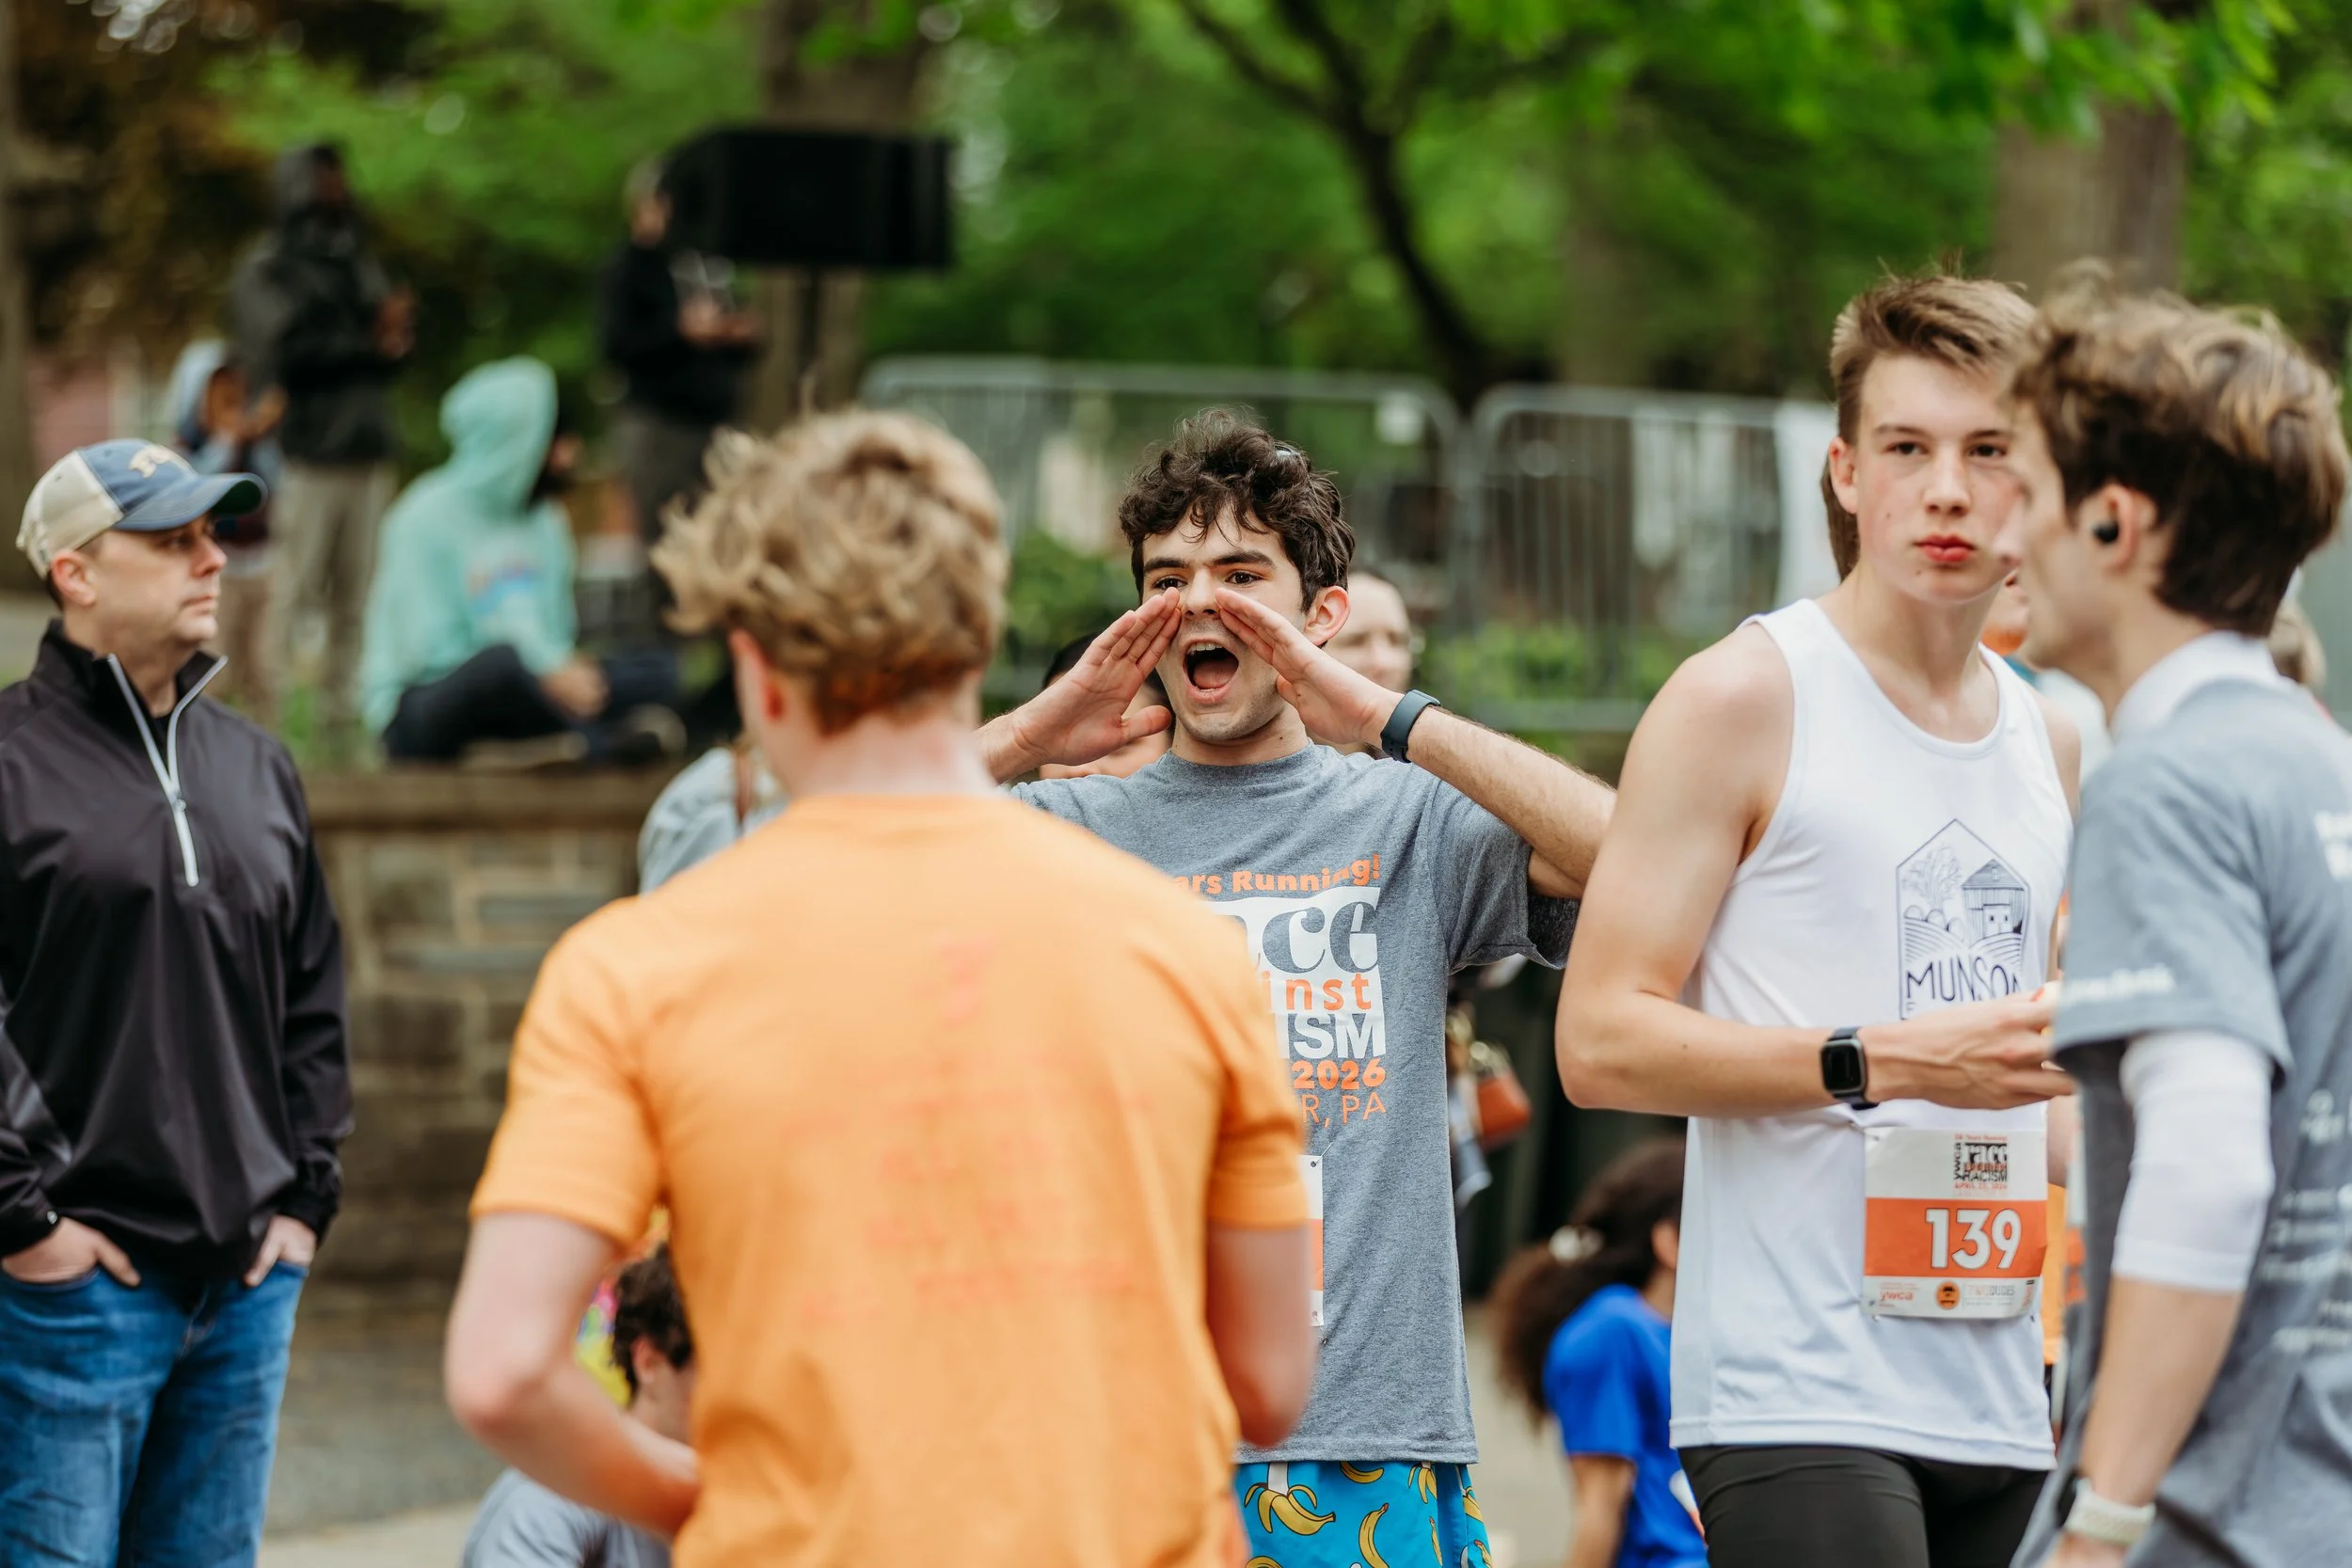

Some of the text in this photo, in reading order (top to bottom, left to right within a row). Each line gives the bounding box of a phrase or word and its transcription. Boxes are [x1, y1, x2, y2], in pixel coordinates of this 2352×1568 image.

[1173, 852, 1380, 895] ars Running!
[1242, 900, 1378, 974] ce
[1262, 971, 1373, 1011] inst
[1276, 1012, 1387, 1059] ISM
[1292, 1057, 1386, 1090] 2026
[1301, 1091, 1387, 1128] R, PA
[1926, 1208, 2021, 1270] 139
